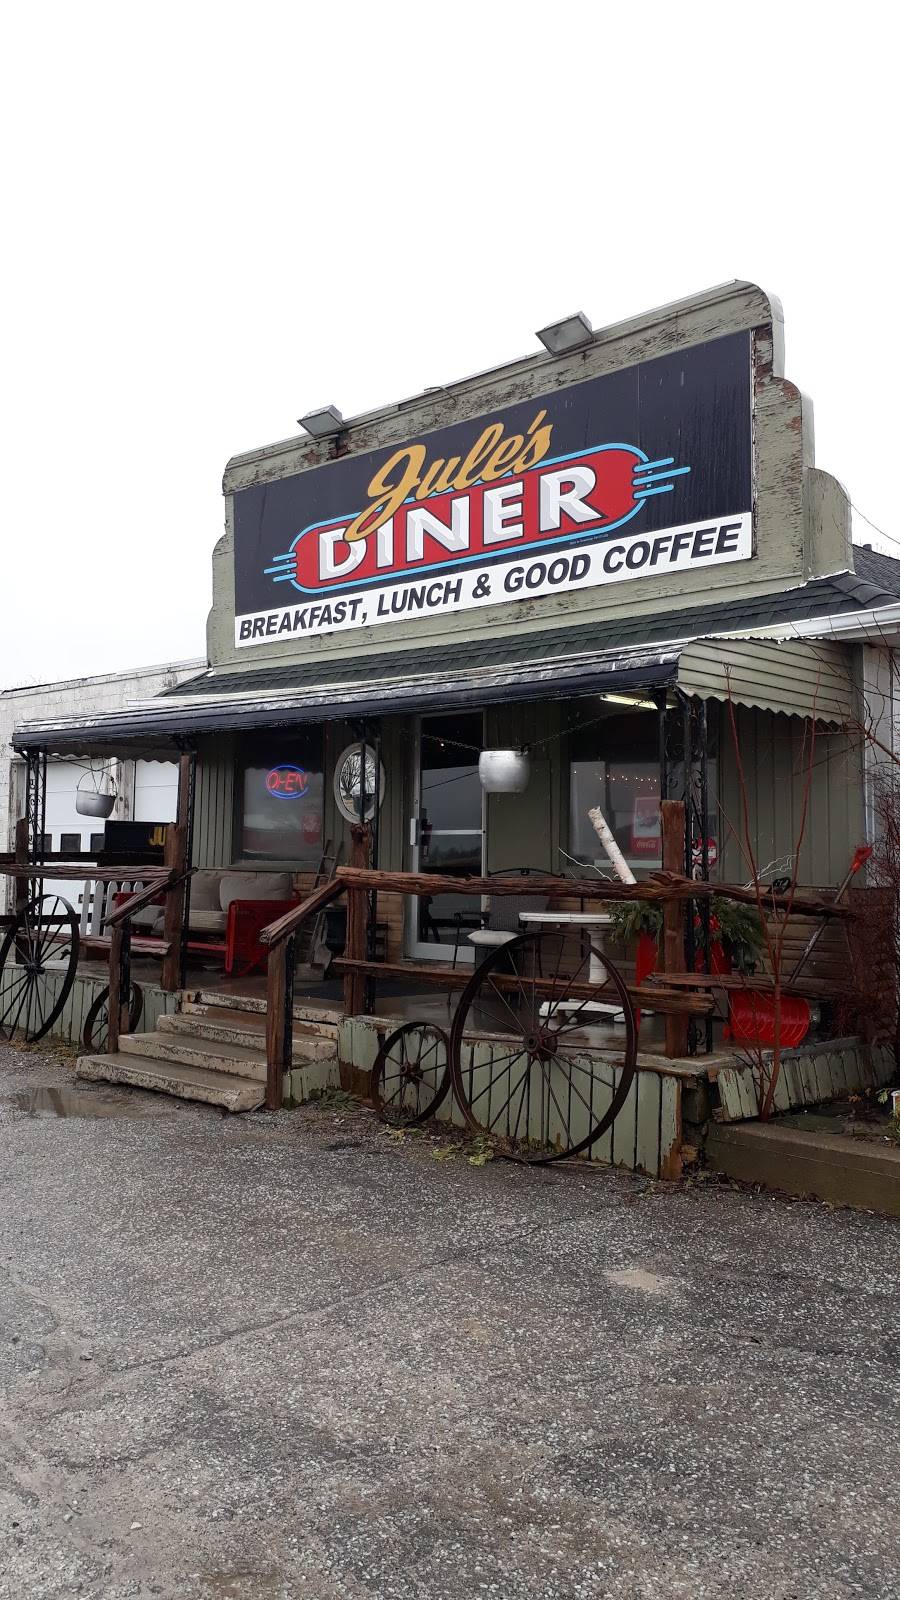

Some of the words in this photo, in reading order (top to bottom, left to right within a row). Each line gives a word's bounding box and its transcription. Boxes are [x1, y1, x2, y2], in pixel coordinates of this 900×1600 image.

[318, 466, 605, 581] DINER
[344, 409, 553, 542] Jule's
[238, 599, 368, 641] BREAKFAST,
[376, 579, 463, 617] LUNCH
[471, 572, 492, 598] &
[504, 553, 592, 592] GOOD
[603, 522, 742, 574] COFFEE
